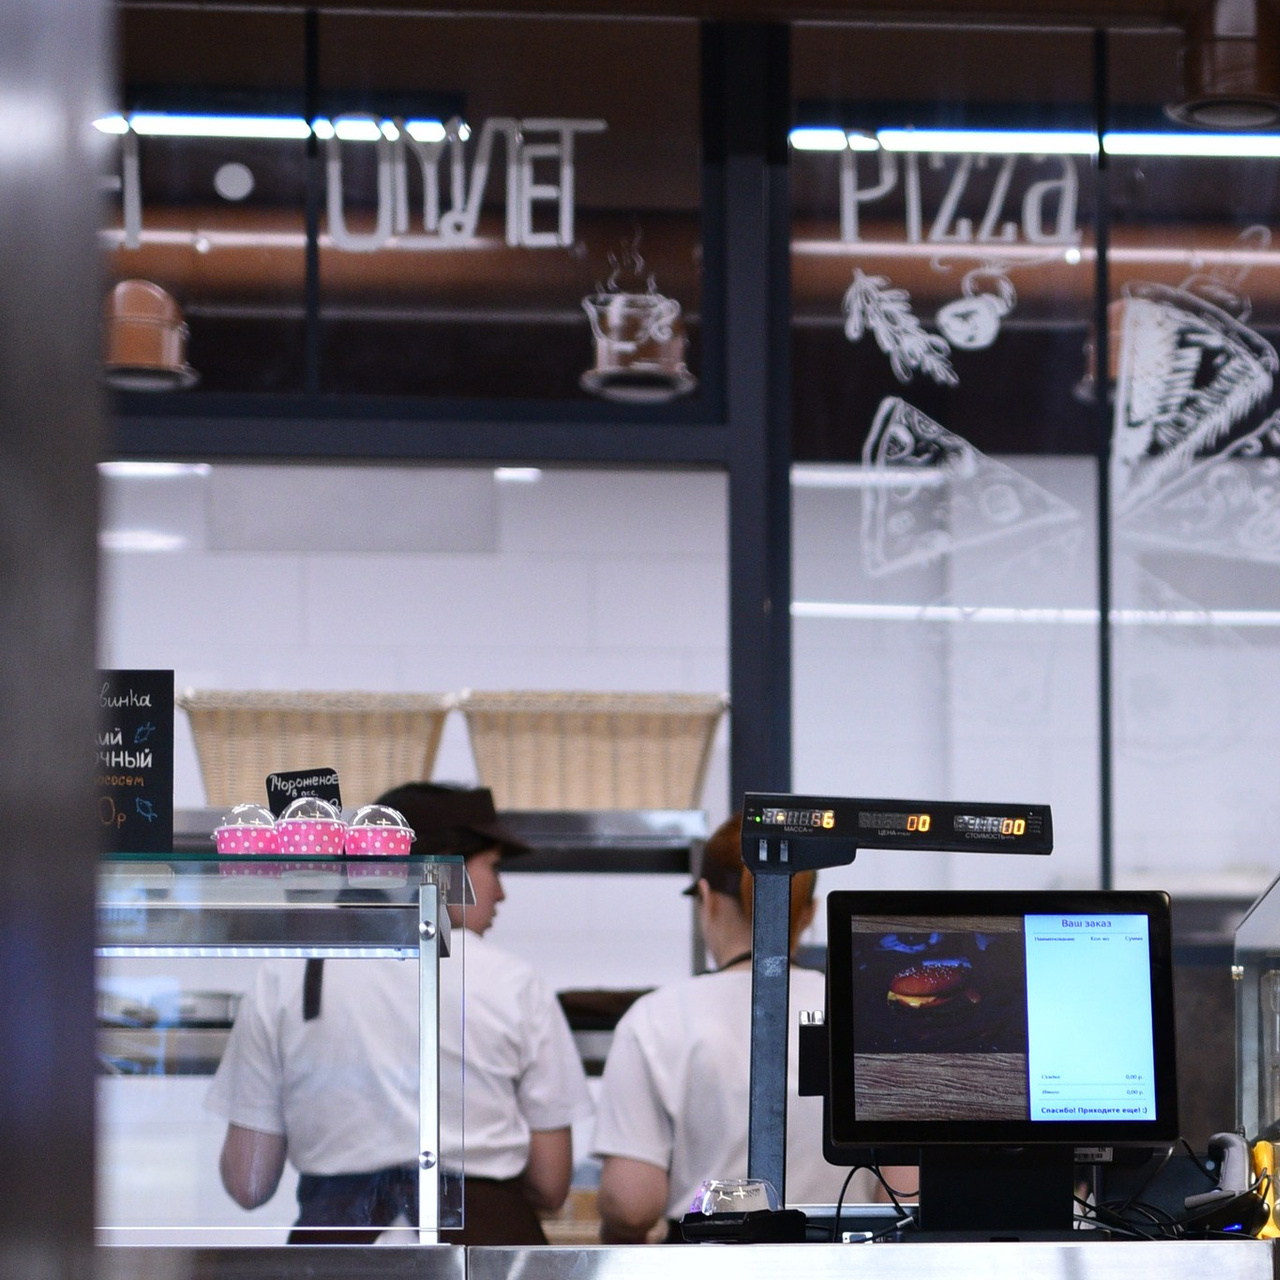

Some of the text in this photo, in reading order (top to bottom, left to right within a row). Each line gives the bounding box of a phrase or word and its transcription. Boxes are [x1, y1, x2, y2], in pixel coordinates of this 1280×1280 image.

[100, 682, 152, 707] винка
[1061, 919, 1111, 928] Ваш заказ
[1078, 1107, 1120, 1115] Приходите
